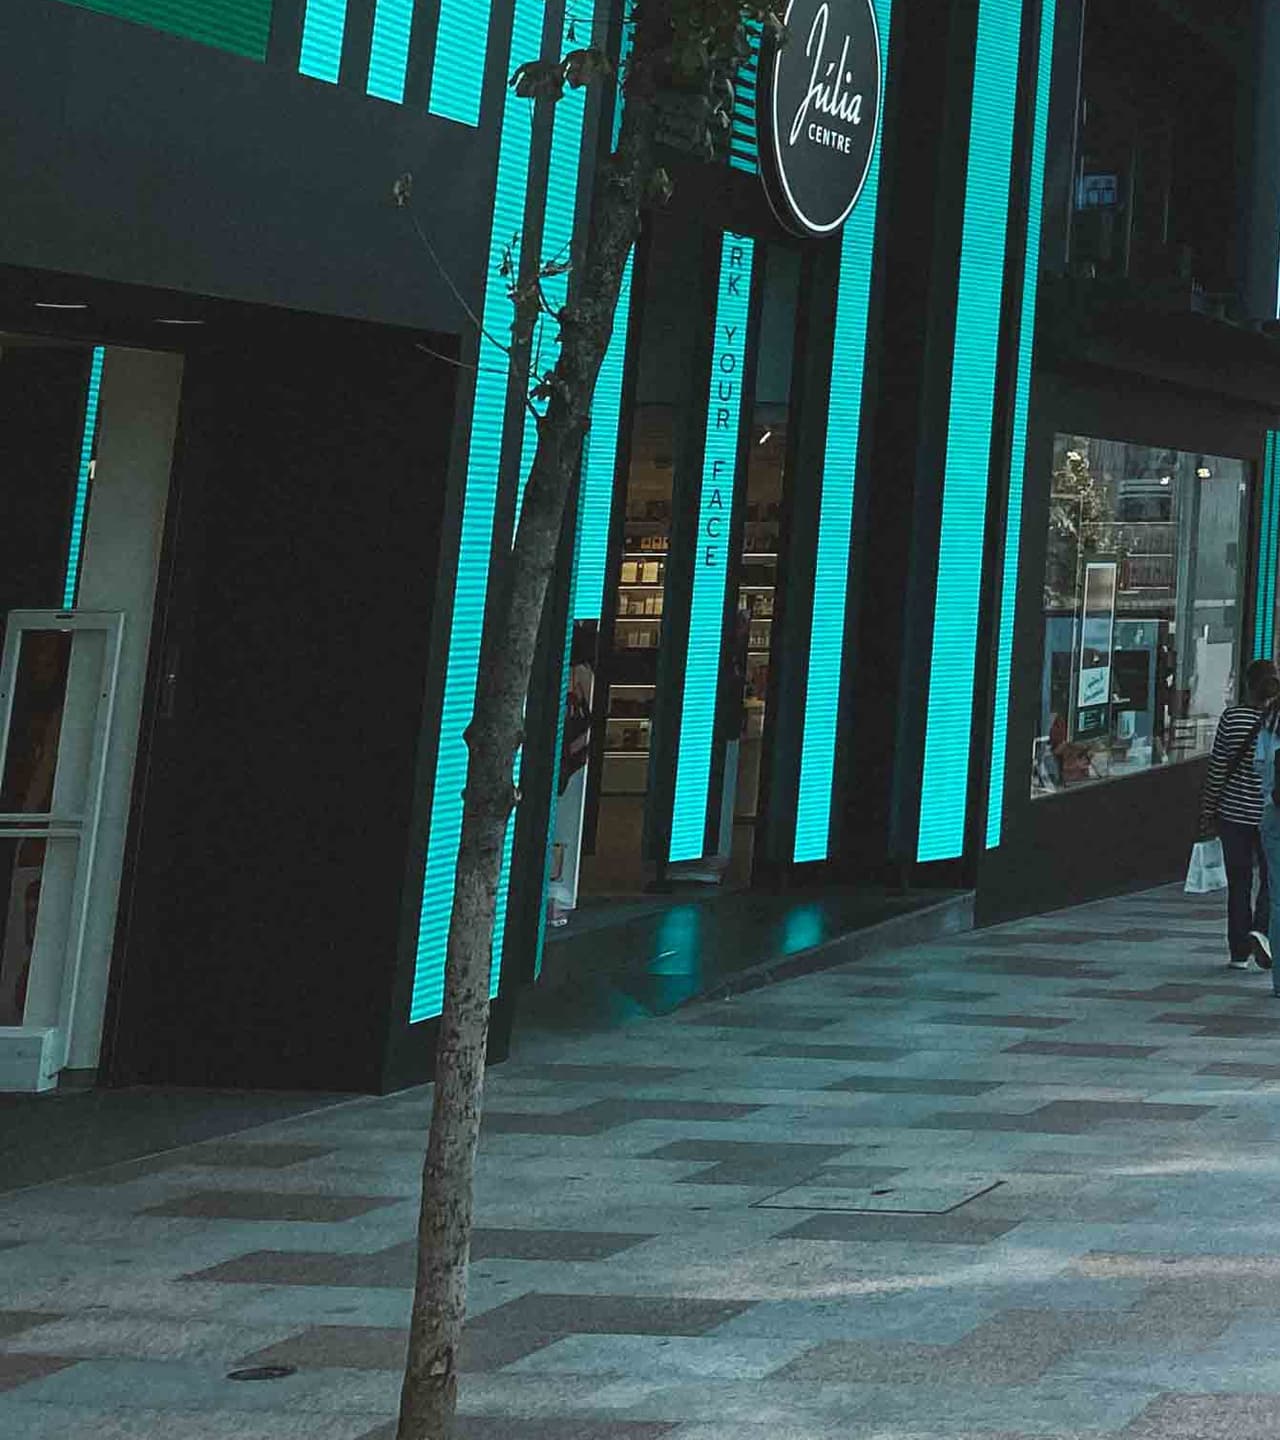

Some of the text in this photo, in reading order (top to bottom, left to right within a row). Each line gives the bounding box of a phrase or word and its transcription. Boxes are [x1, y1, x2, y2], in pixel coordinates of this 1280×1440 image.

[789, 2, 863, 145] Júlia
[808, 123, 851, 154] CENTRE
[705, 232, 745, 566] RK YOUR FACE
